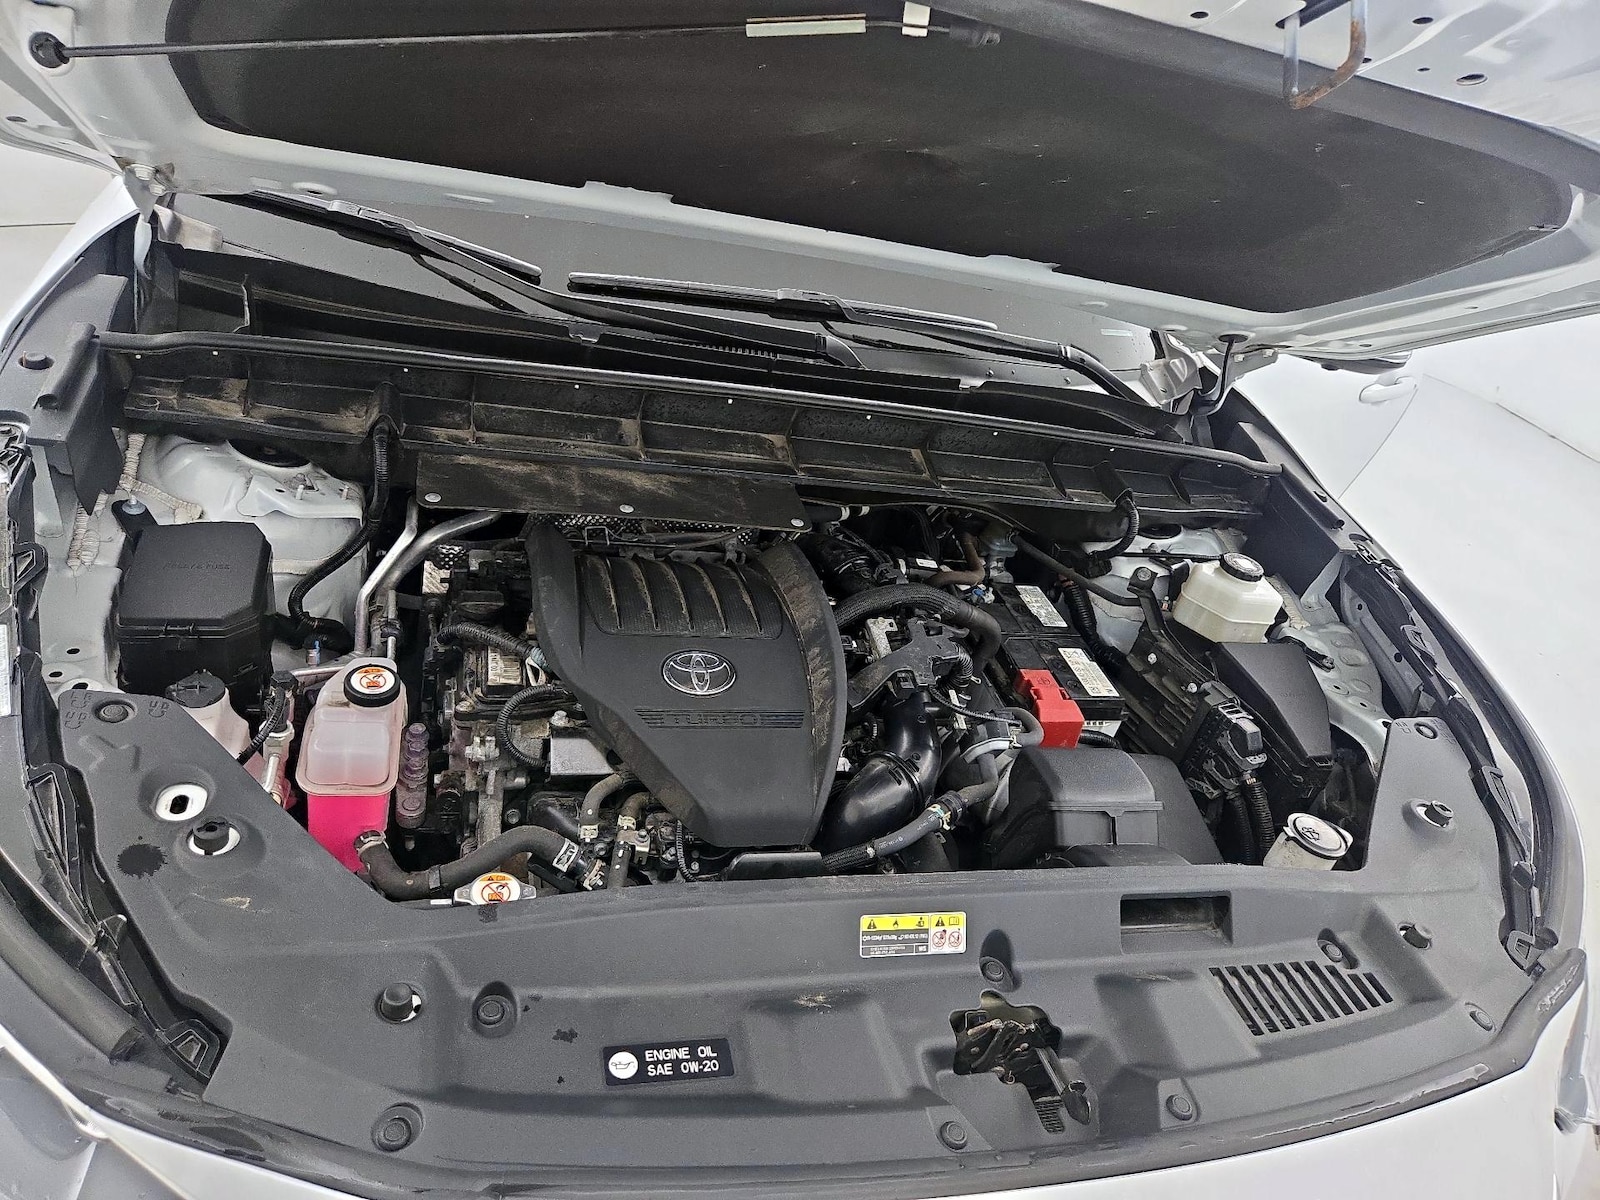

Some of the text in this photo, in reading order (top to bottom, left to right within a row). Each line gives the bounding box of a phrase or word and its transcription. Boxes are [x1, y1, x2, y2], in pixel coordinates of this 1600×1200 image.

[665, 712, 759, 727] TURBO
[645, 1045, 717, 1062] ENGINE OIL
[647, 1060, 719, 1076] SAE 0W-20
